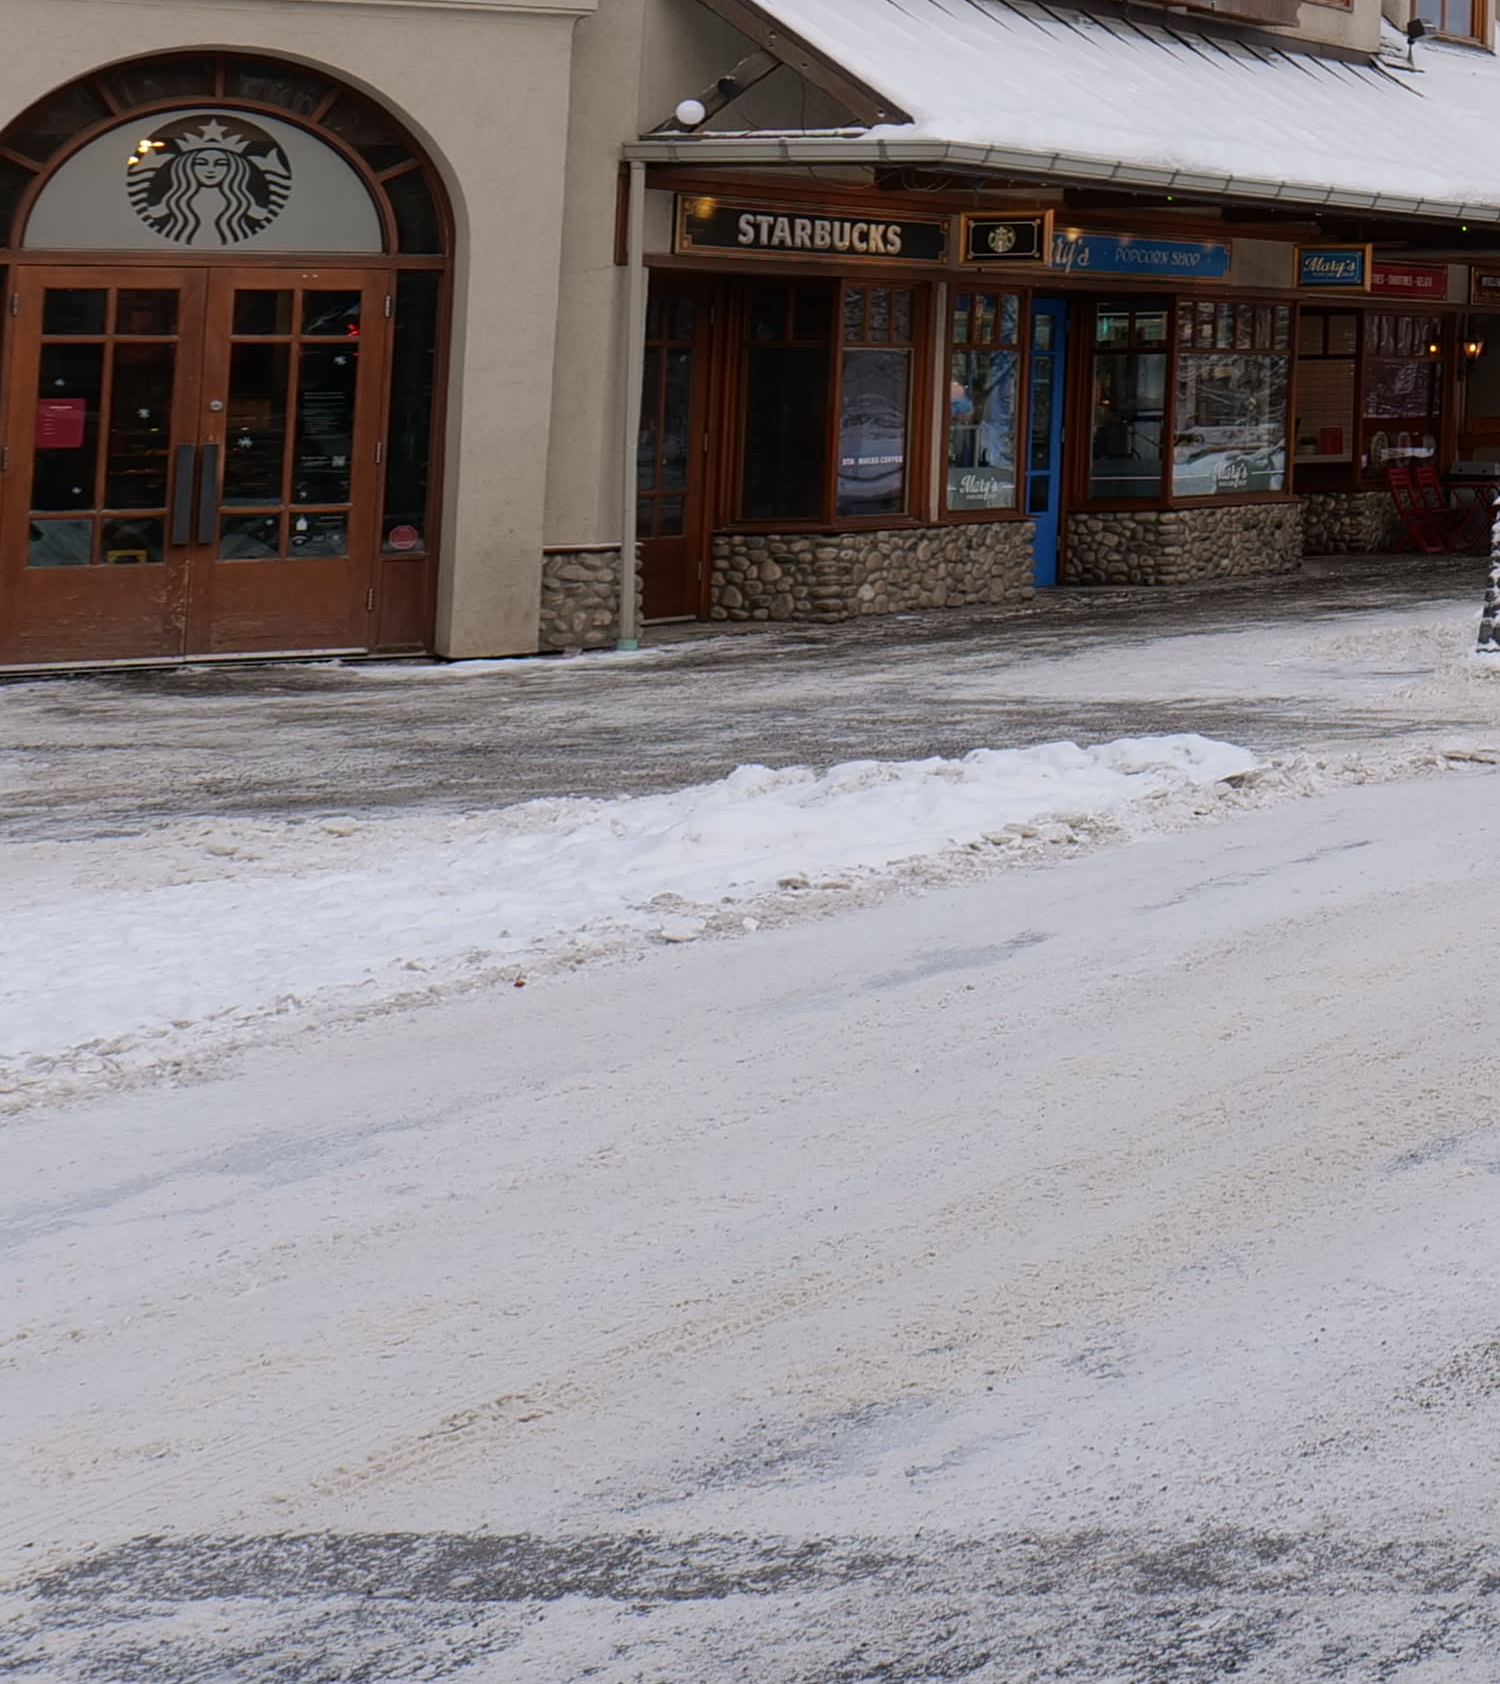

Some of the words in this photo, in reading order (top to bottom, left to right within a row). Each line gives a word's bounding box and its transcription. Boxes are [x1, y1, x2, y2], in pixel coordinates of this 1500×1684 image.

[737, 213, 901, 255] STARBUCKS
[1114, 246, 1169, 265] POPCORN
[1171, 250, 1202, 268] SHOP
[1303, 254, 1357, 279] Mary's
[960, 474, 1000, 500] Mary's
